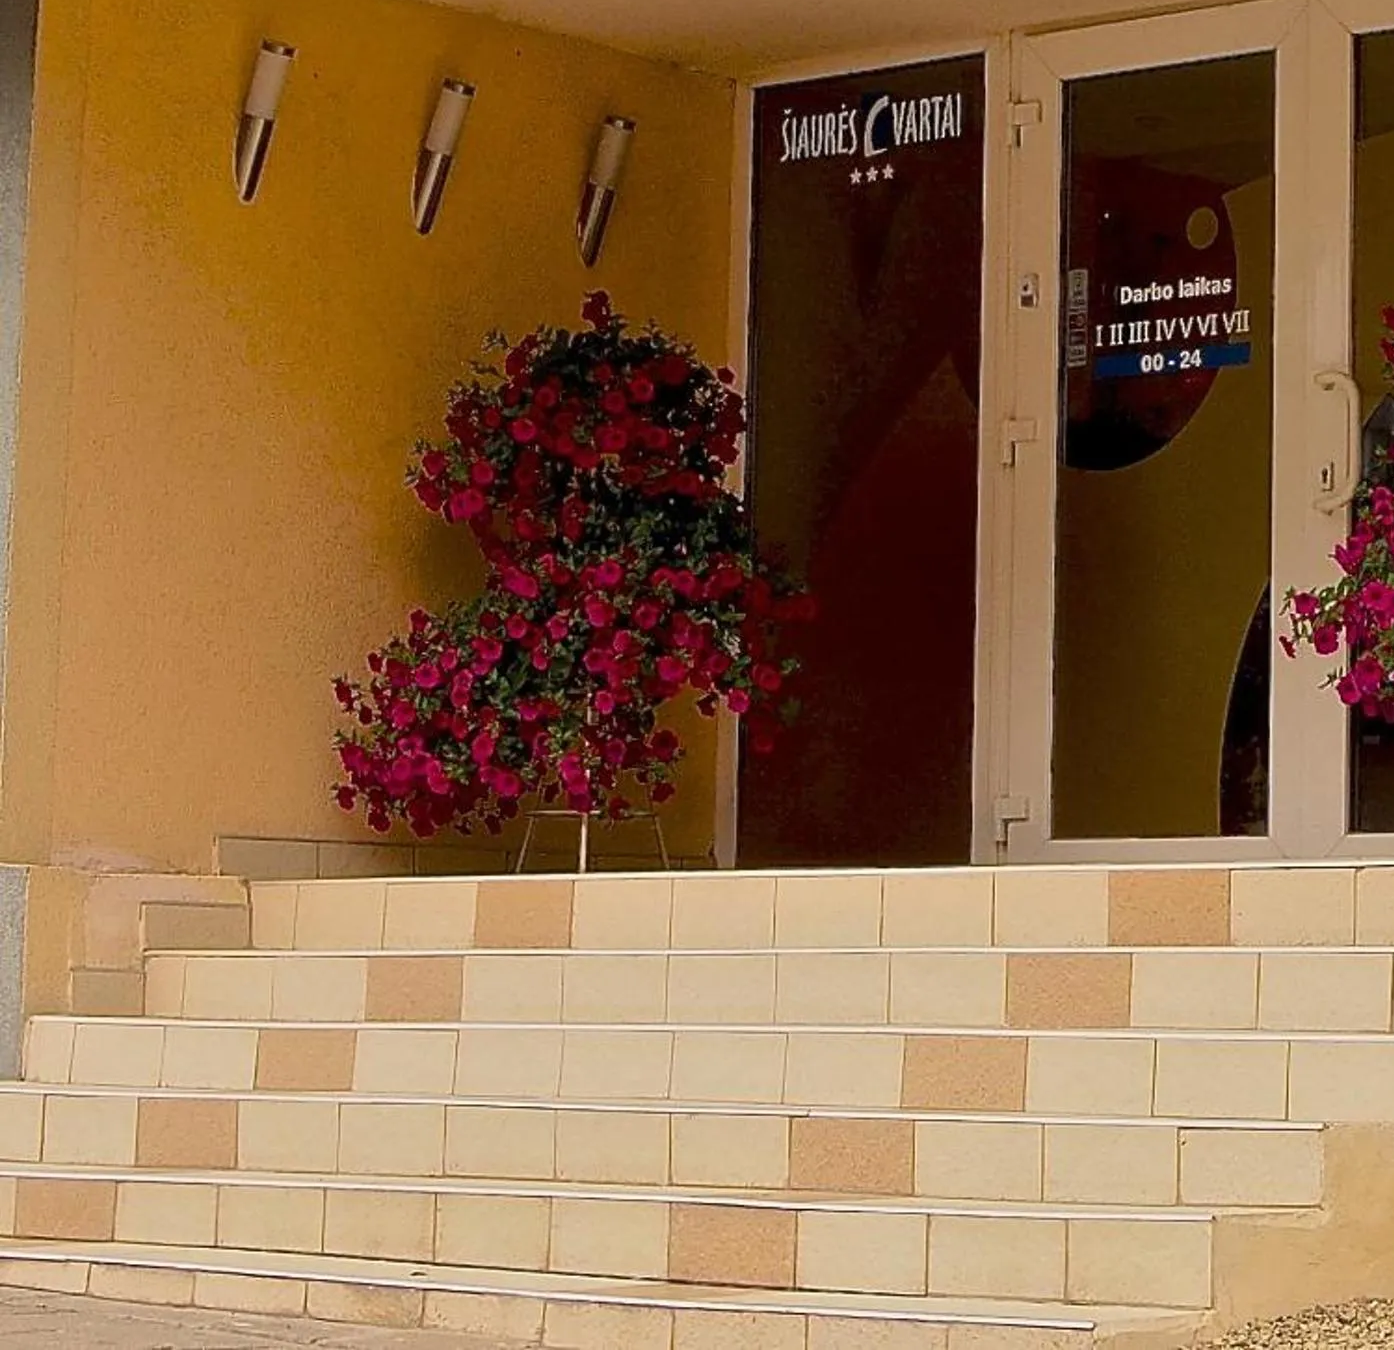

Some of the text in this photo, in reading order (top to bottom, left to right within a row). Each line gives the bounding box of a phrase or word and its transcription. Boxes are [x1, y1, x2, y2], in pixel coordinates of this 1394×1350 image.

[780, 103, 858, 162] ŠIAURĖS
[891, 92, 962, 146] VARTAI
[1120, 276, 1232, 305] Darbo laikas
[1095, 309, 1251, 347] I II III IV V VI VII
[1140, 353, 1165, 373] 00
[1179, 348, 1203, 369] 24
